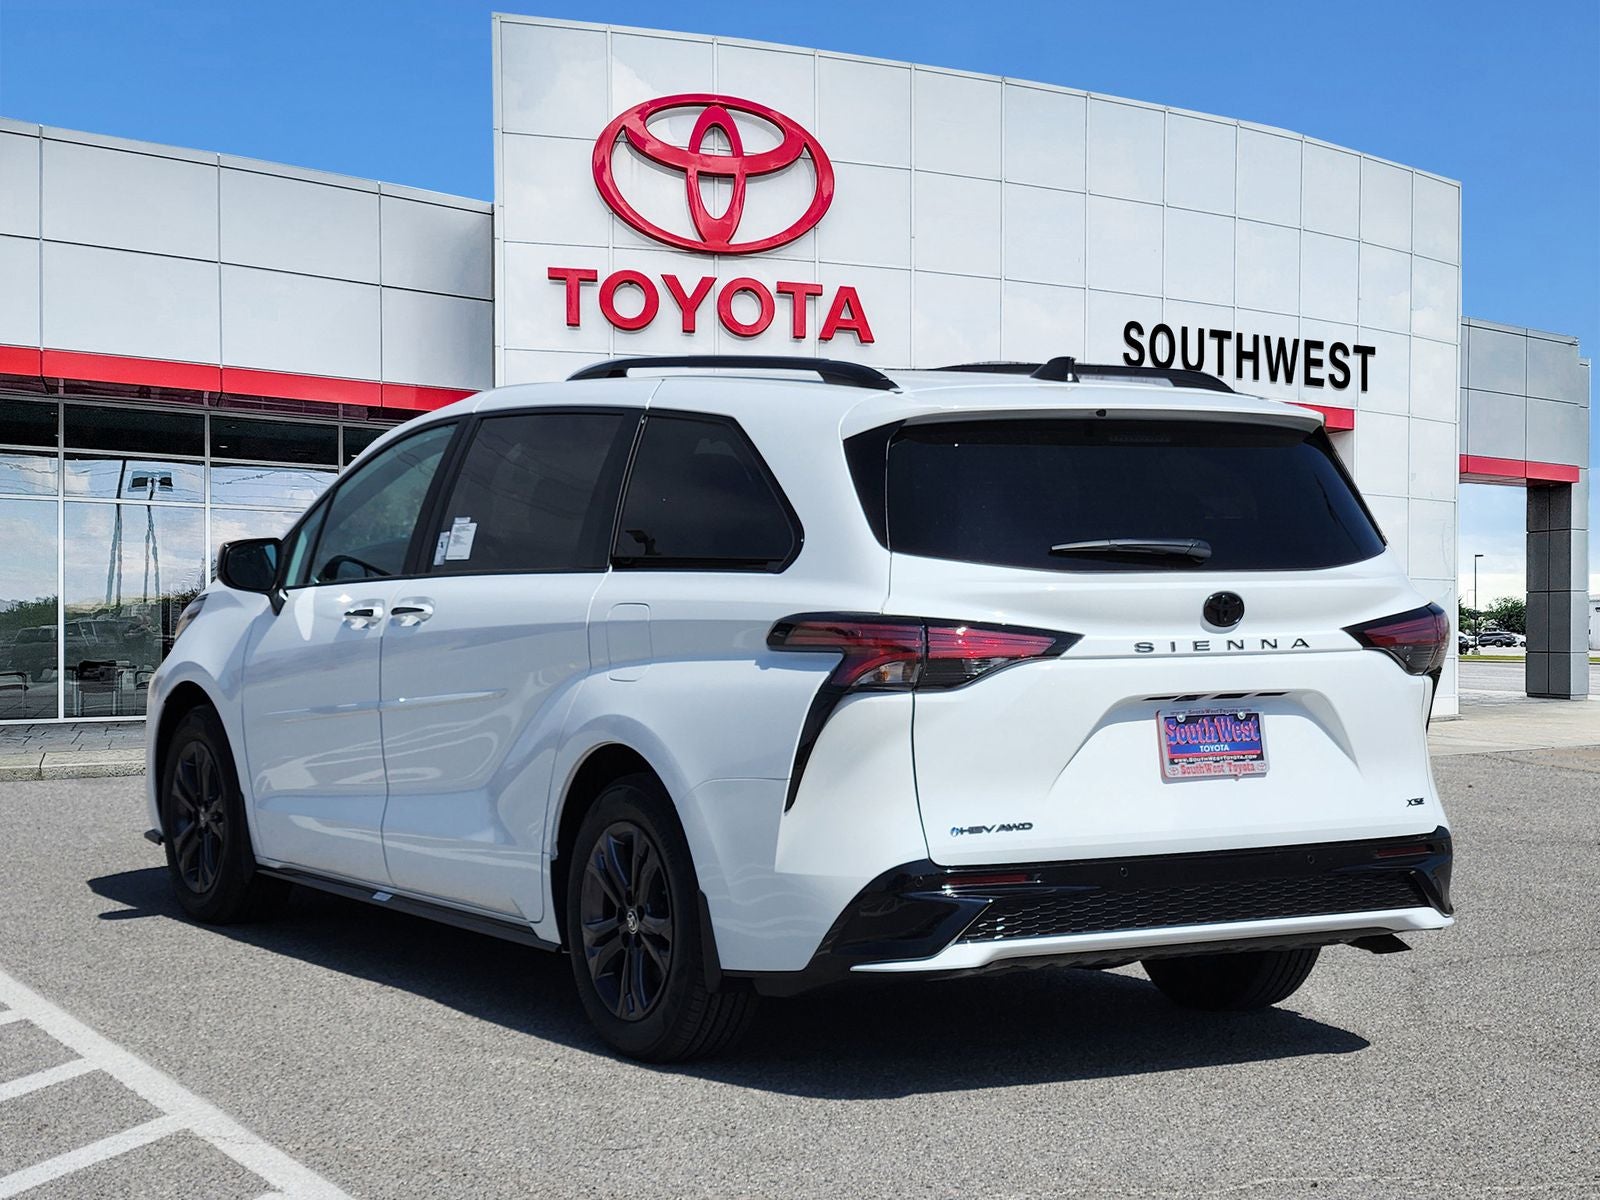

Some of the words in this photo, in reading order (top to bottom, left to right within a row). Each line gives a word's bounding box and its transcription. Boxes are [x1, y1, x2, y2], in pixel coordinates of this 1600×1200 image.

[548, 267, 875, 344] TOYOTA
[1123, 321, 1376, 392] SOUTHWEST
[1134, 638, 1310, 653] SIENNA
[1199, 744, 1230, 752] TOYOTA
[1228, 762, 1255, 775] Toyota
[1406, 797, 1425, 807] XSE
[959, 824, 996, 835] HEV
[996, 822, 1033, 832] AWD
